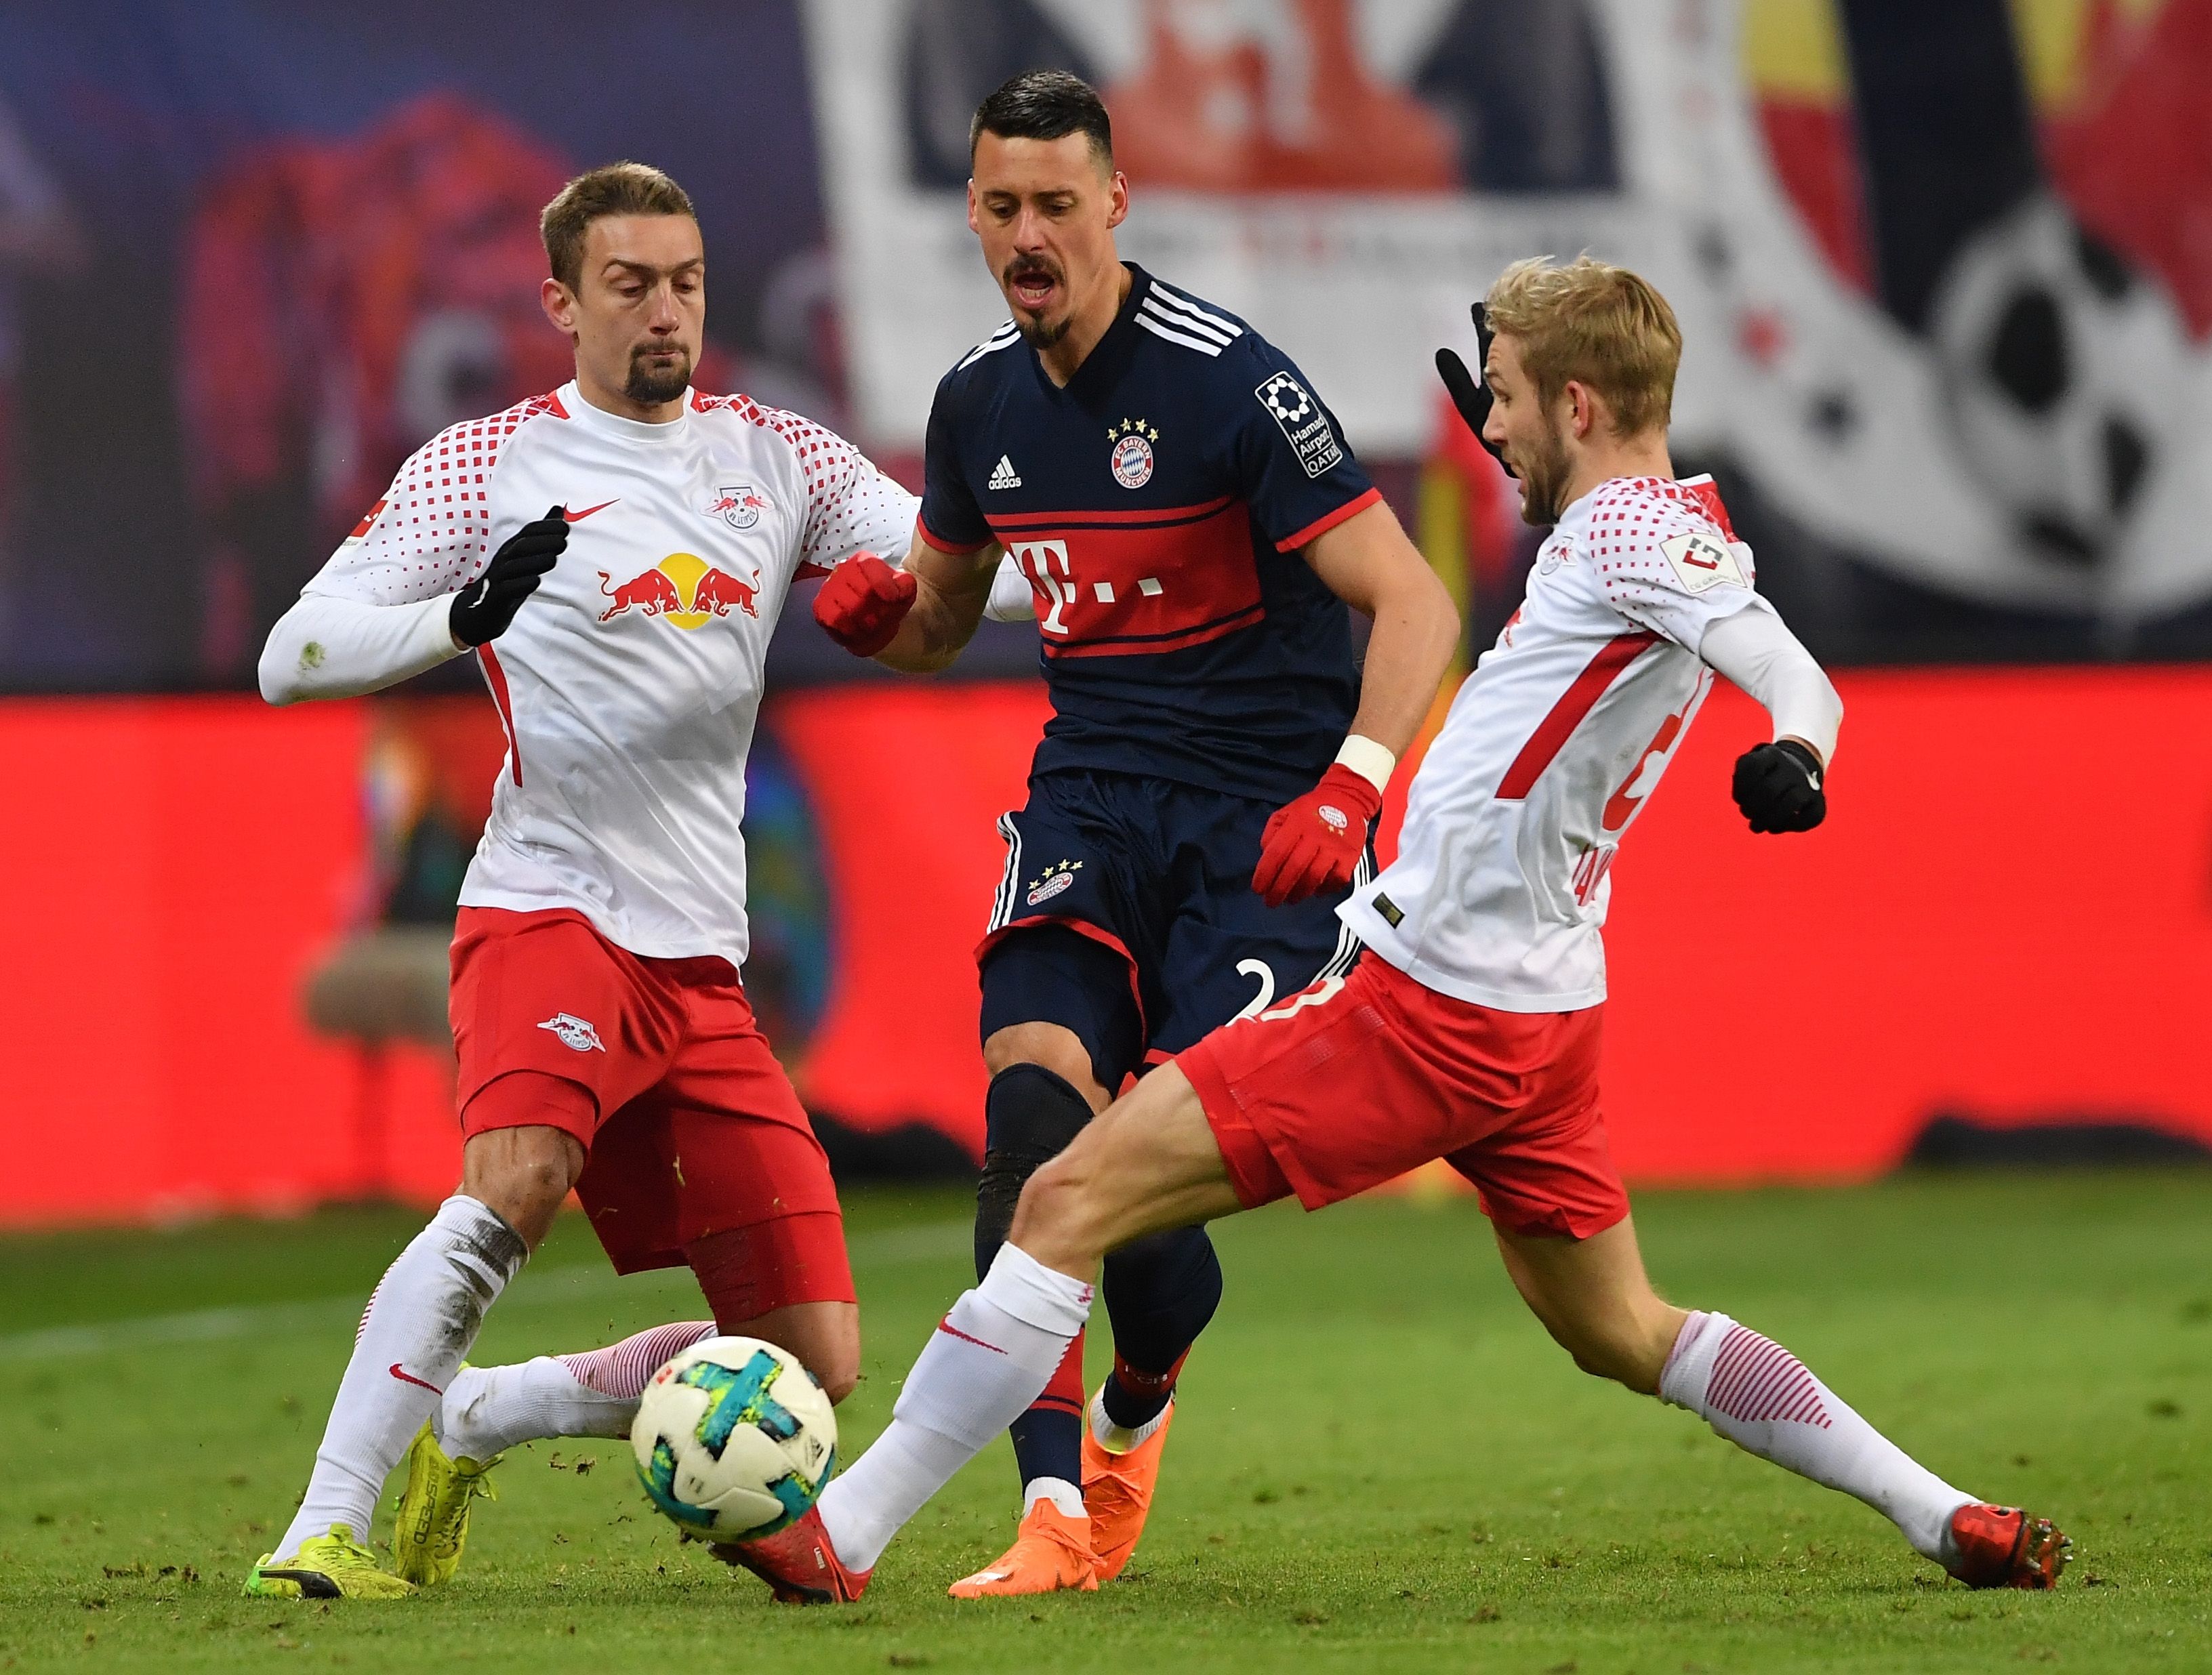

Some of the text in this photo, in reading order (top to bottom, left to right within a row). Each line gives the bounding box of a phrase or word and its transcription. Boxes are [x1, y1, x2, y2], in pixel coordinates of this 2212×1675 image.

[1291, 413, 1324, 444] Hamad
[1299, 428, 1330, 457] Airport
[1115, 439, 1151, 459] FC BAYERN
[1307, 444, 1339, 473] QATAR
[988, 476, 1022, 490] adidas
[1225, 958, 1275, 1027] 2
